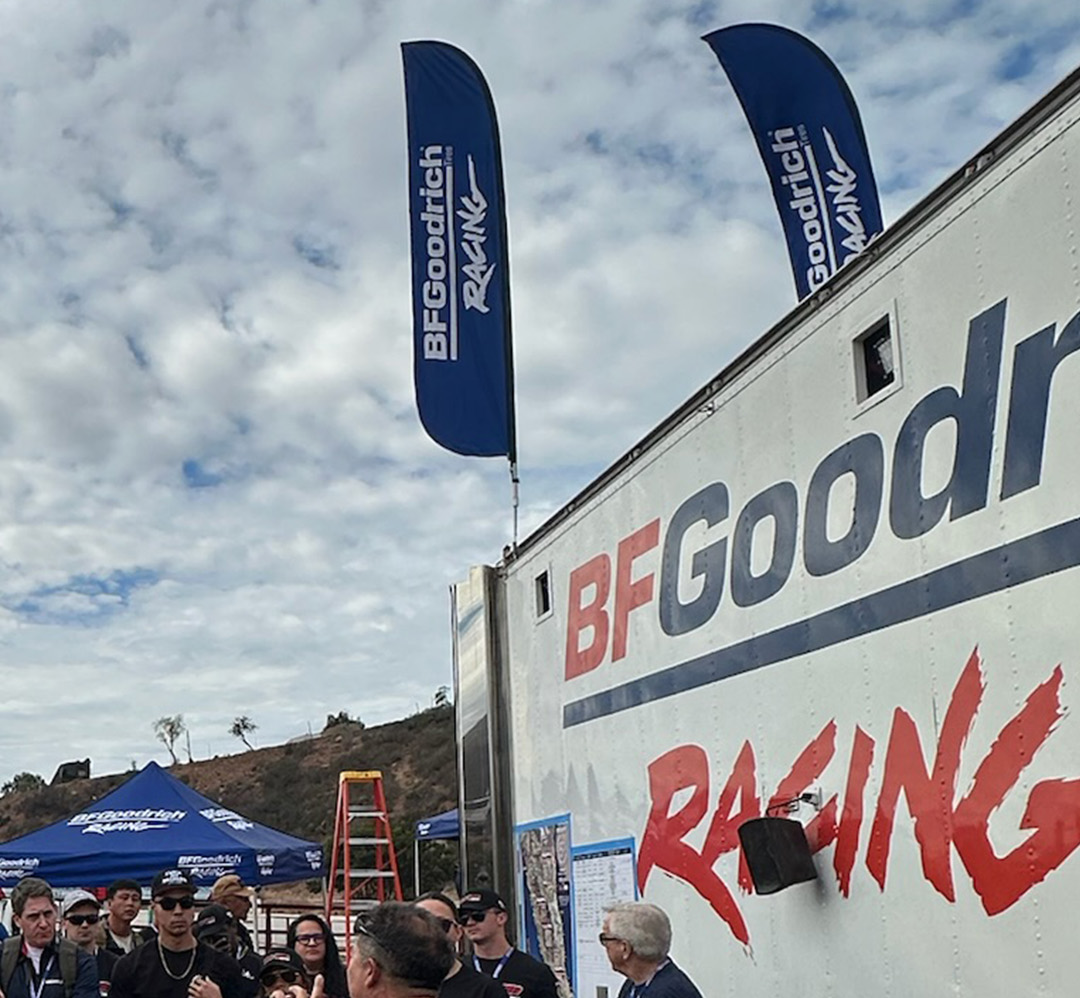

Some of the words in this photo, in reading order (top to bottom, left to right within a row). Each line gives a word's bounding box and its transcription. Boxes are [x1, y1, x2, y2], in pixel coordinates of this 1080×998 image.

[420, 145, 448, 361] BFGoodrich
[456, 154, 497, 314] RACING
[69, 808, 187, 823] BFGoodrich
[178, 854, 241, 864] BFGoodrich
